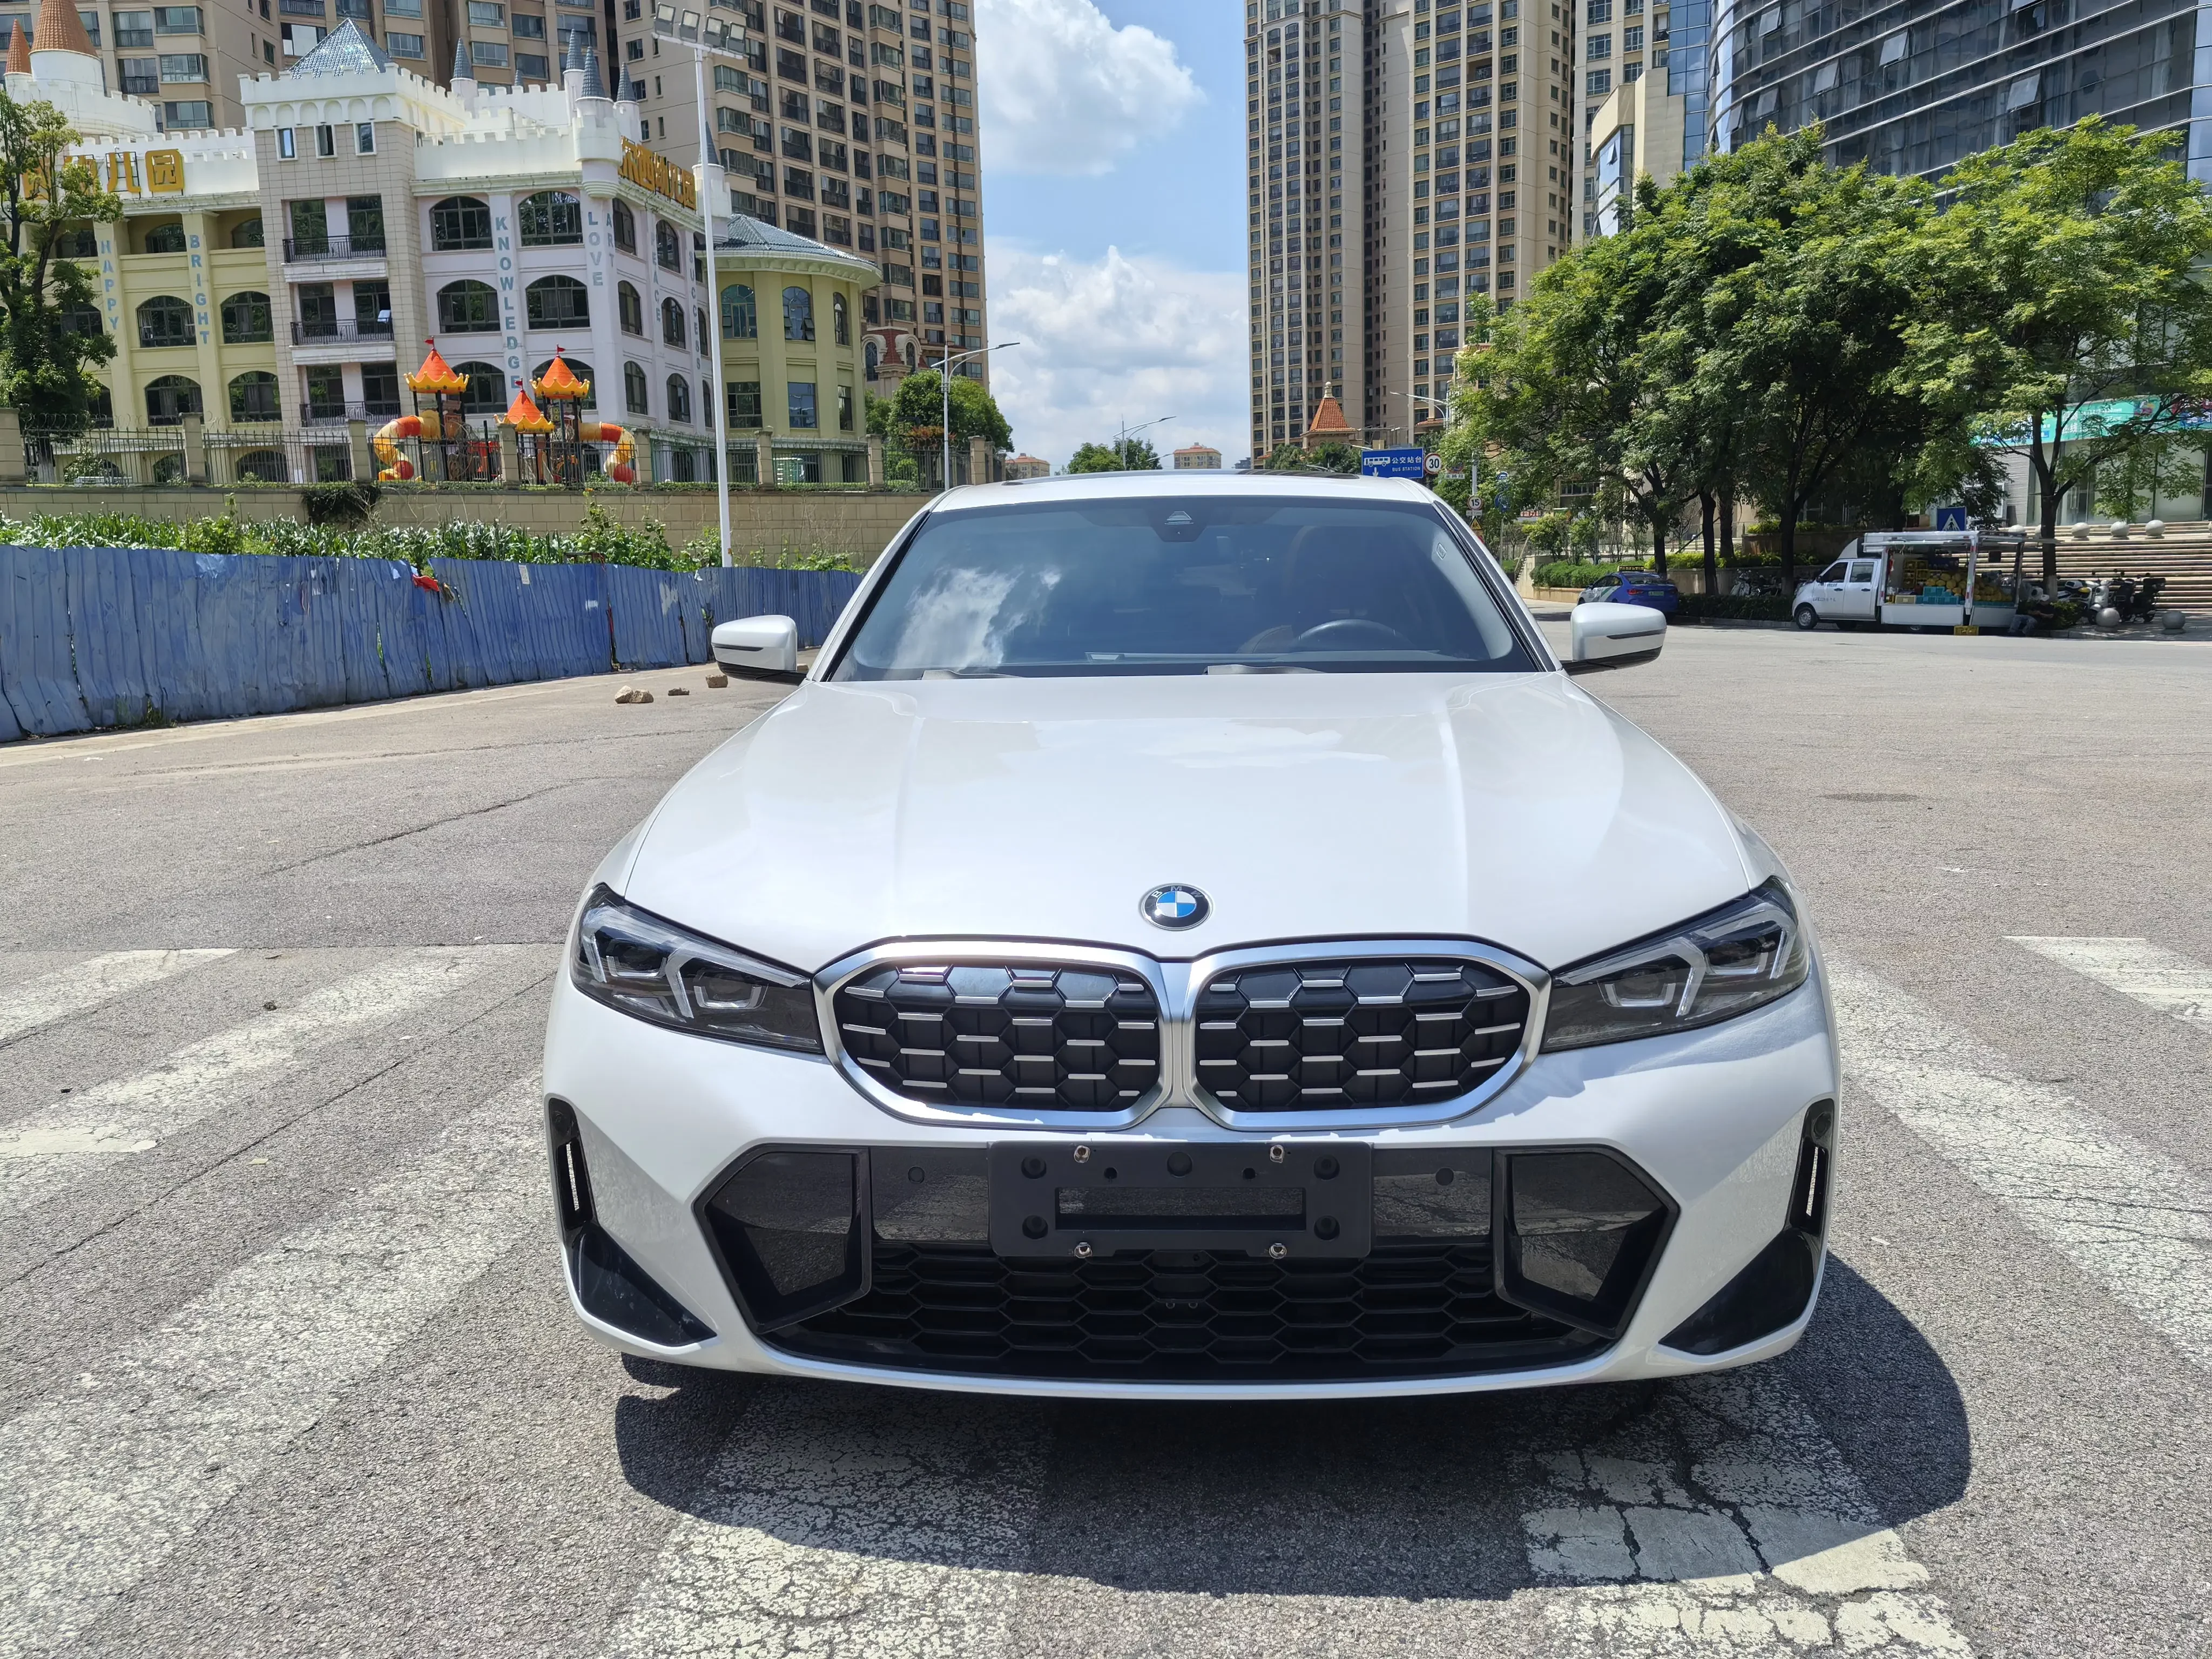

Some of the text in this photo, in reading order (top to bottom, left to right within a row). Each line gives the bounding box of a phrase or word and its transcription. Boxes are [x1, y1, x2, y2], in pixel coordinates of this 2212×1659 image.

[588, 212, 603, 286] LOVE
[606, 213, 615, 267] ART
[651, 232, 660, 322] PEACE
[100, 240, 119, 331] HAPPY
[190, 234, 210, 345] BRIGHT
[495, 217, 520, 389] KNOWLEDGE
[689, 251, 700, 370] SUCCESS
[1391, 456, 1422, 464] 公交站台
[1429, 458, 1439, 469] 30
[1151, 886, 1203, 899] BMW
